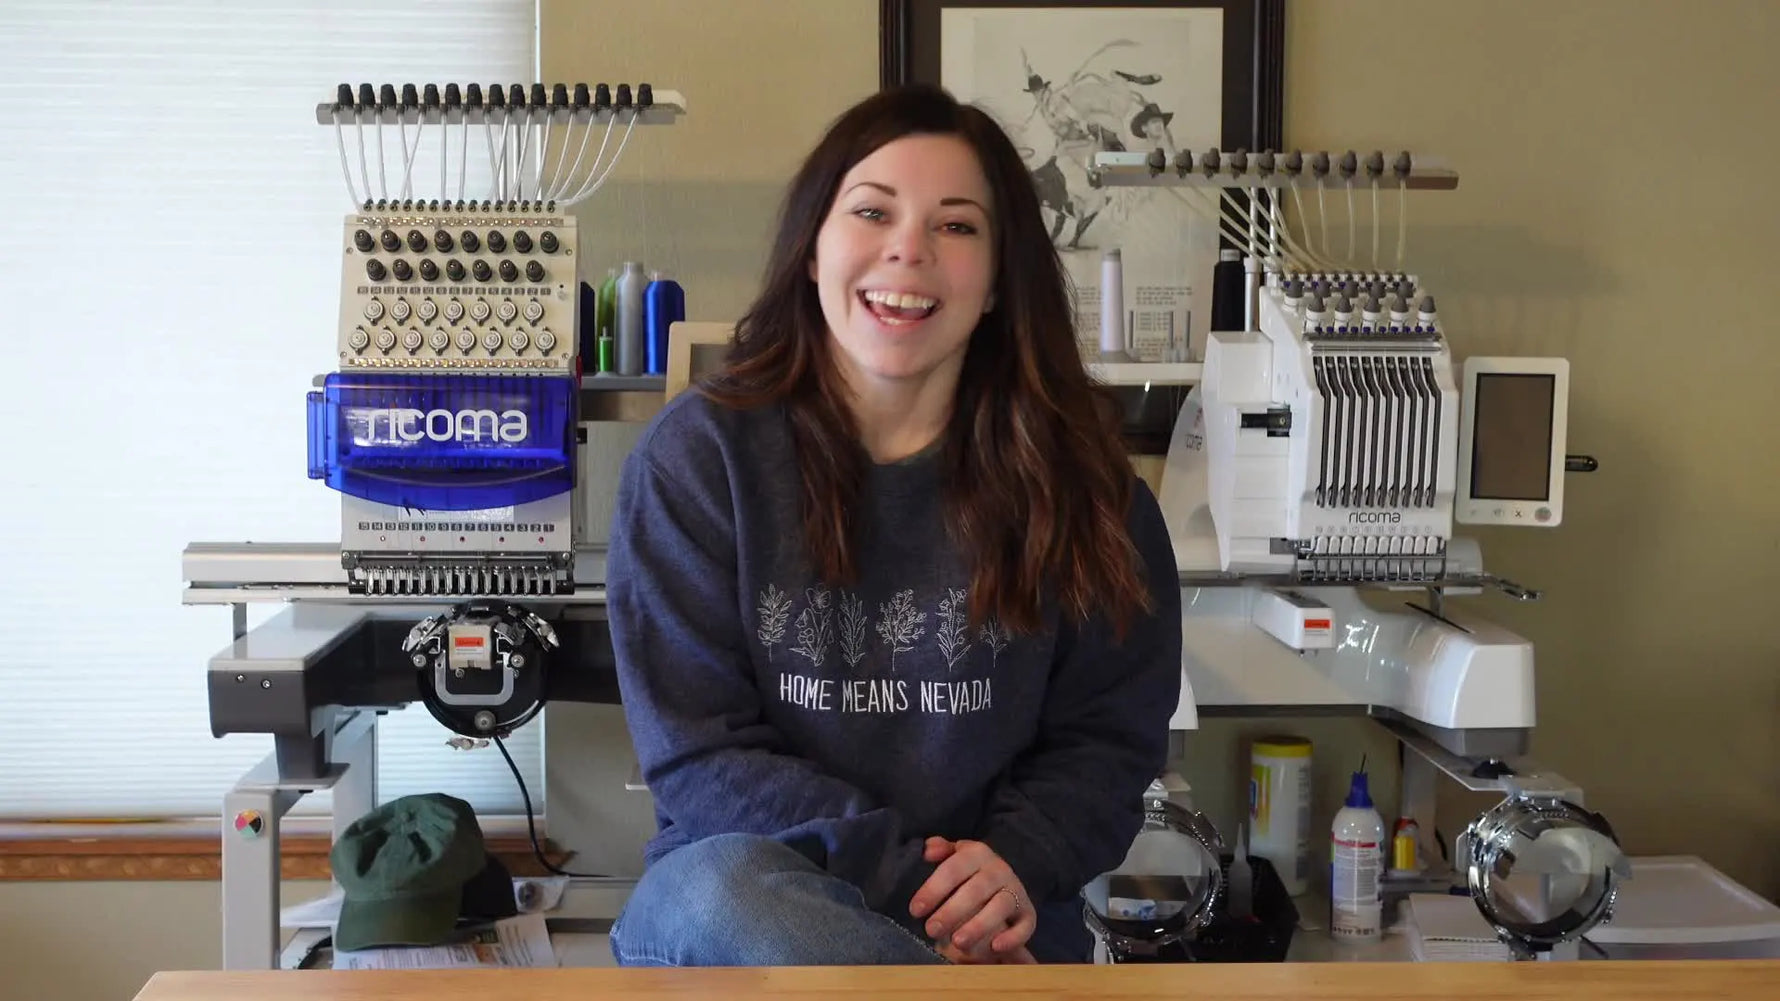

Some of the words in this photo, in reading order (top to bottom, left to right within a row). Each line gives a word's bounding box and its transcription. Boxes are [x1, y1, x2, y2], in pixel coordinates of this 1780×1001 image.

[368, 408, 527, 441] ricoma
[1349, 512, 1401, 524] ricoma
[780, 672, 834, 710] HOME
[842, 679, 909, 713] MEANS
[920, 678, 992, 715] NEVADA
